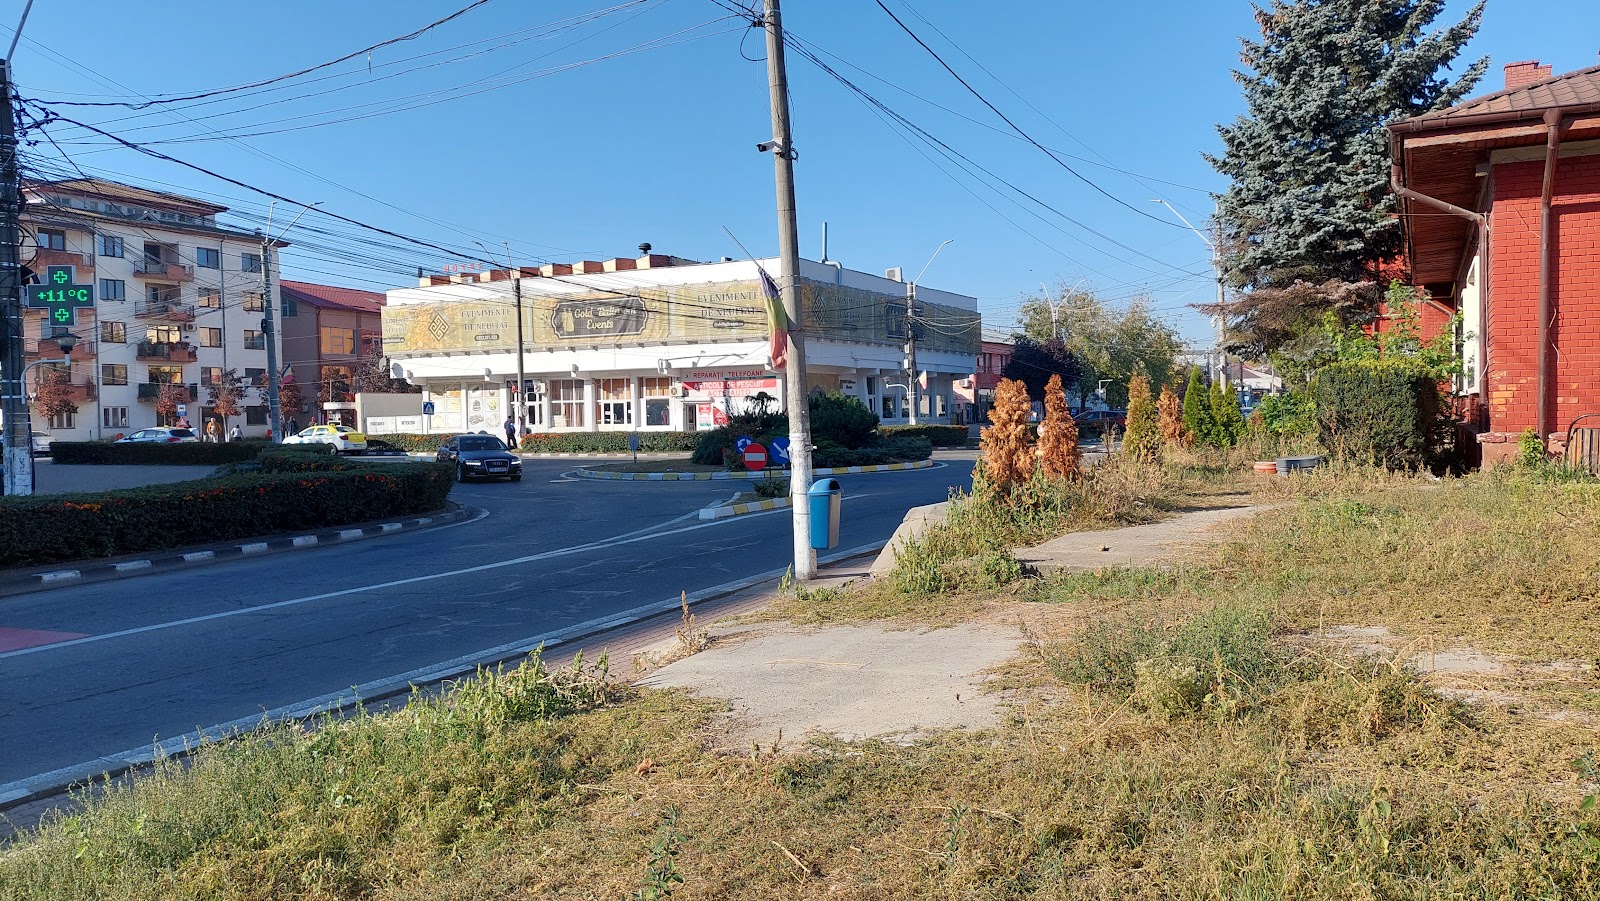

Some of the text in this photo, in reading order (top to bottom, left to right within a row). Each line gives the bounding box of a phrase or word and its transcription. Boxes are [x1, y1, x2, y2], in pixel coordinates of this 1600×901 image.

[697, 292, 760, 302] EVENIMENTE
[461, 308, 512, 318] EVENIMENTE
[574, 308, 593, 318] Gold
[701, 309, 714, 317] DE
[586, 319, 614, 329] Events
[728, 370, 764, 378] TELEFOANE
